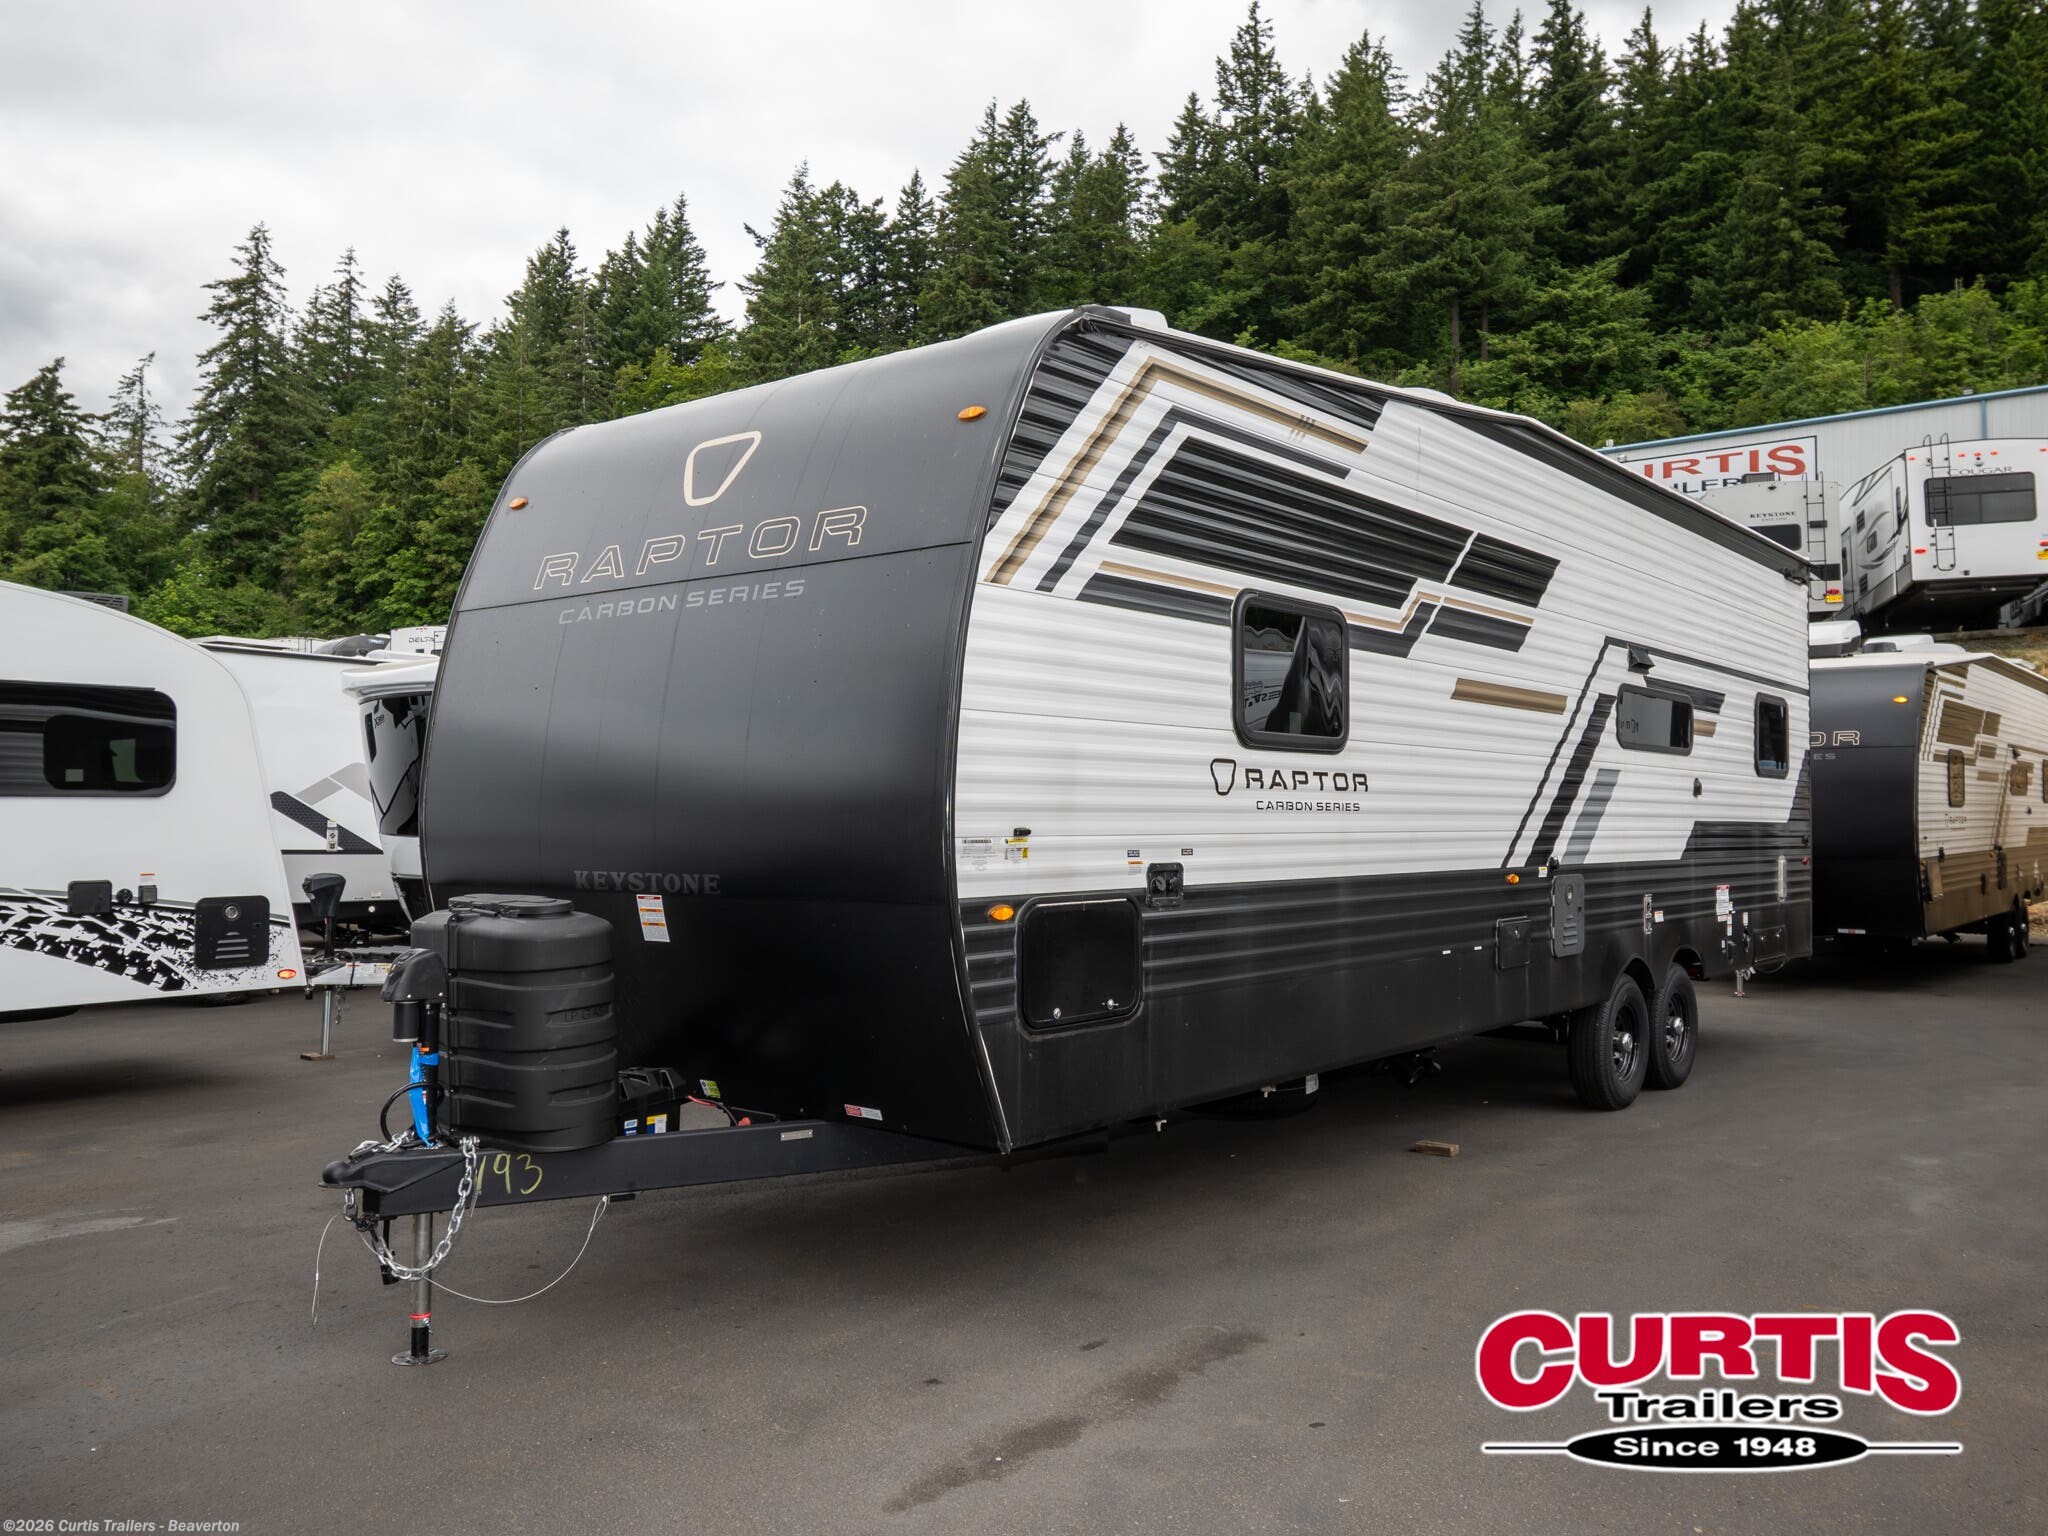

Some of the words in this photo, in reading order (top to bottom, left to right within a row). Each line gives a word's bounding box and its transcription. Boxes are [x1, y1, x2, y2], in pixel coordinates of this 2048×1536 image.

[1750, 511, 1796, 519] KEYSTONE
[533, 505, 868, 590] RAPTOR
[558, 594, 678, 625] CARBON
[685, 579, 806, 608] SERIES
[1244, 768, 1369, 792] RAPTOR
[1256, 800, 1313, 811] CARBON
[1316, 802, 1361, 812] SERIES
[574, 870, 721, 895] KEYSTONE
